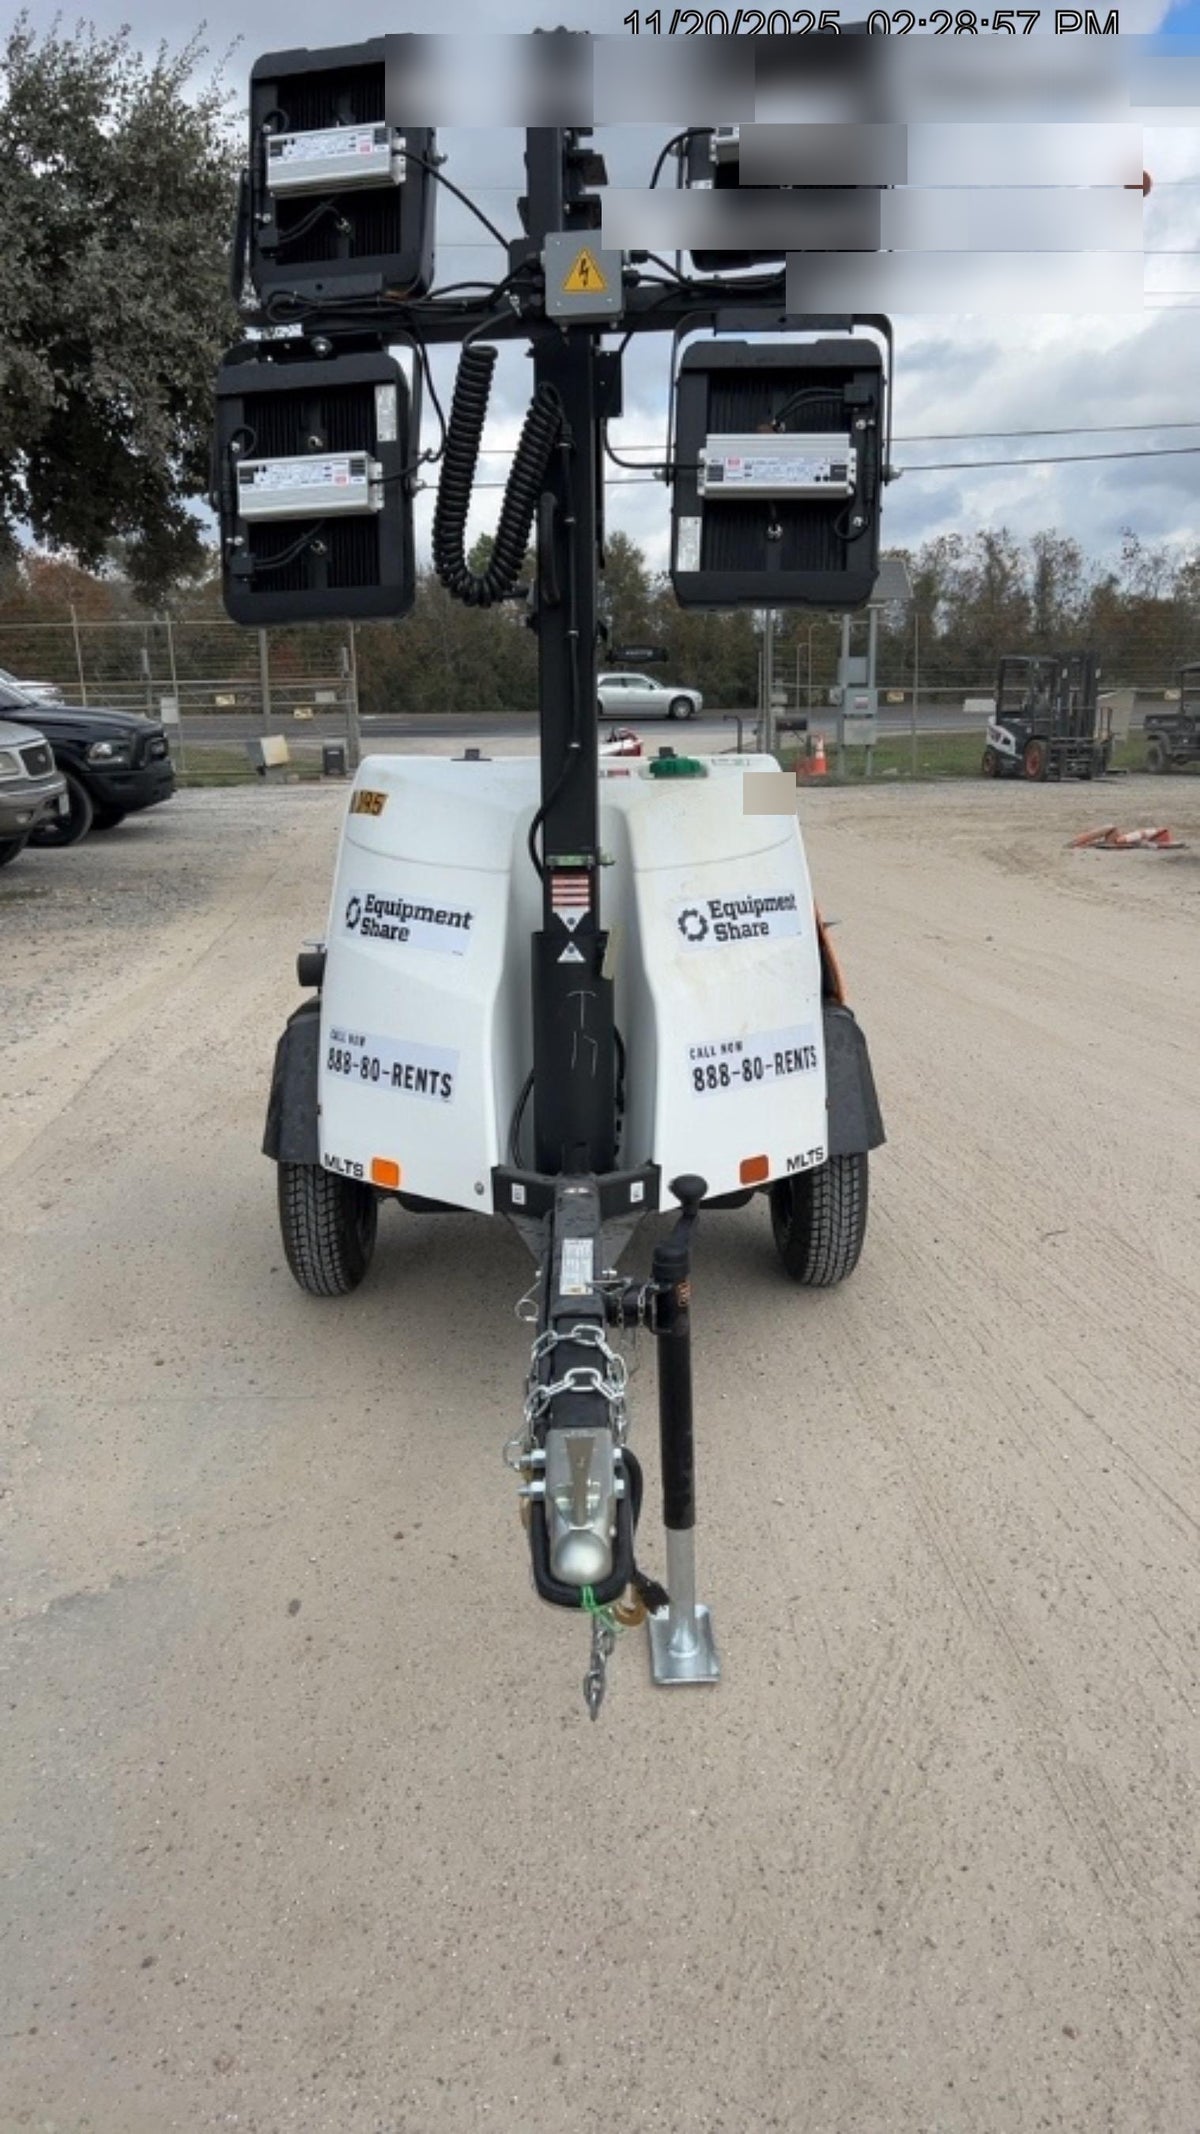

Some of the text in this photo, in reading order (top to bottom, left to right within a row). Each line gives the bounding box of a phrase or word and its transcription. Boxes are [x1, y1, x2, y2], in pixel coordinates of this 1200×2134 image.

[365, 893, 473, 930] Equipment
[707, 894, 797, 920] Equipment
[360, 917, 410, 942] Share
[713, 921, 769, 941] Share
[689, 1040, 742, 1060] CALL NOW
[327, 1047, 453, 1098] 888-80-RENTS
[693, 1045, 816, 1091] 888-80-RENTS
[324, 1153, 363, 1177] MLTS
[785, 1145, 823, 1172] MLTS
